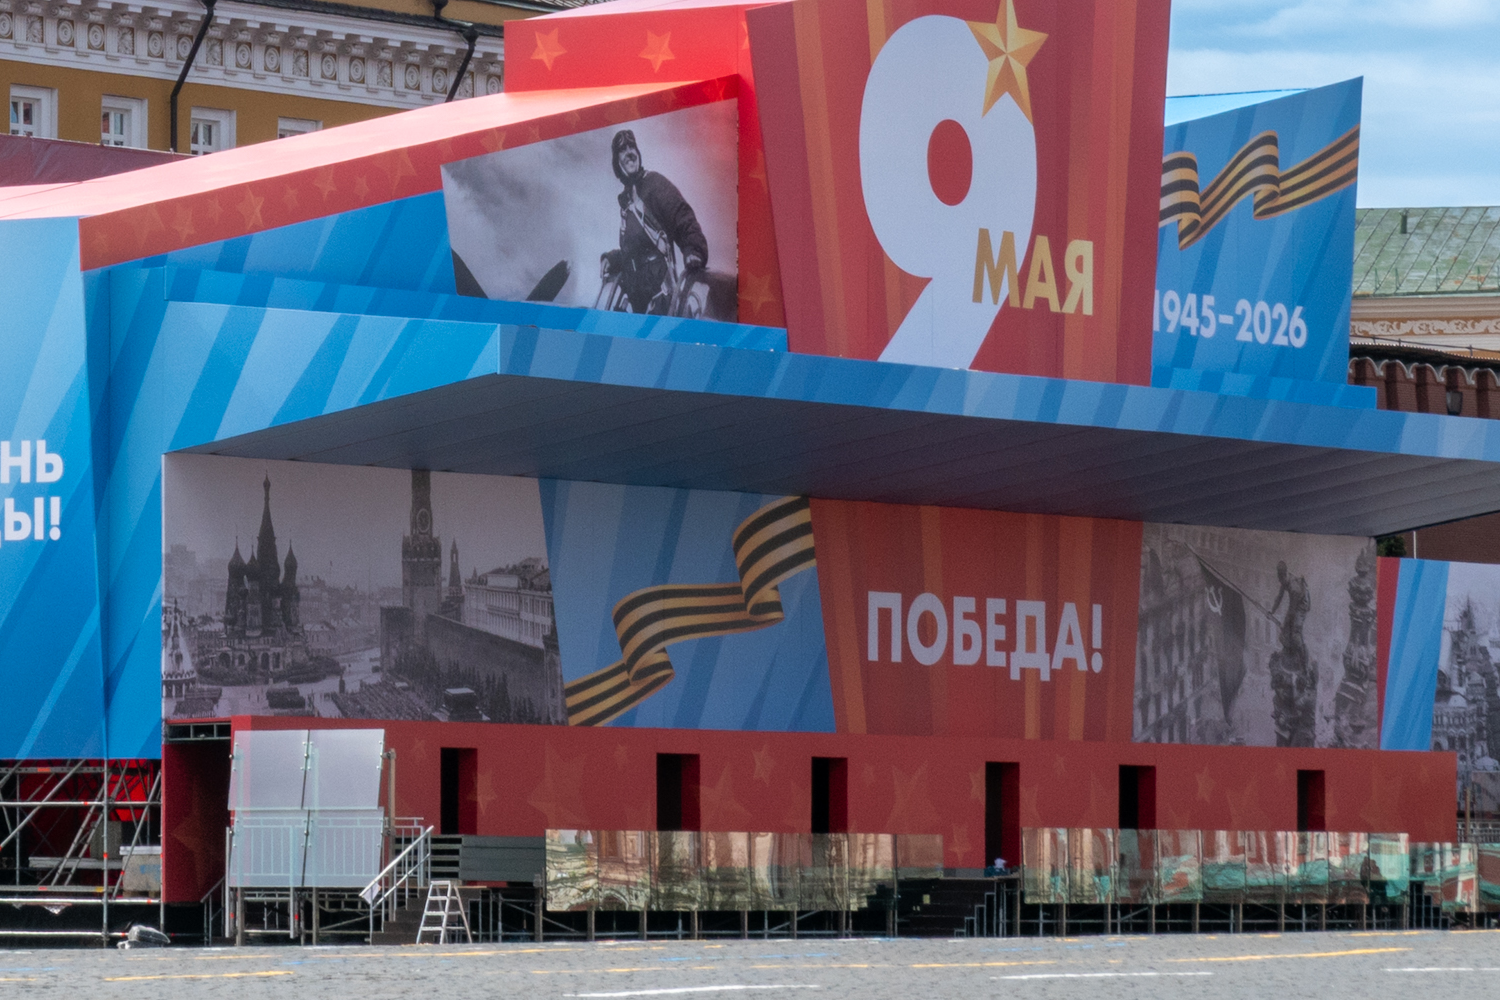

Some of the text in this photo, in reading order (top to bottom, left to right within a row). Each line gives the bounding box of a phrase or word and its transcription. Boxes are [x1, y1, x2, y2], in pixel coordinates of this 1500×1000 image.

[858, 14, 1094, 370] 9 МАЯ
[867, 590, 1103, 682] ПОБЕДА!
